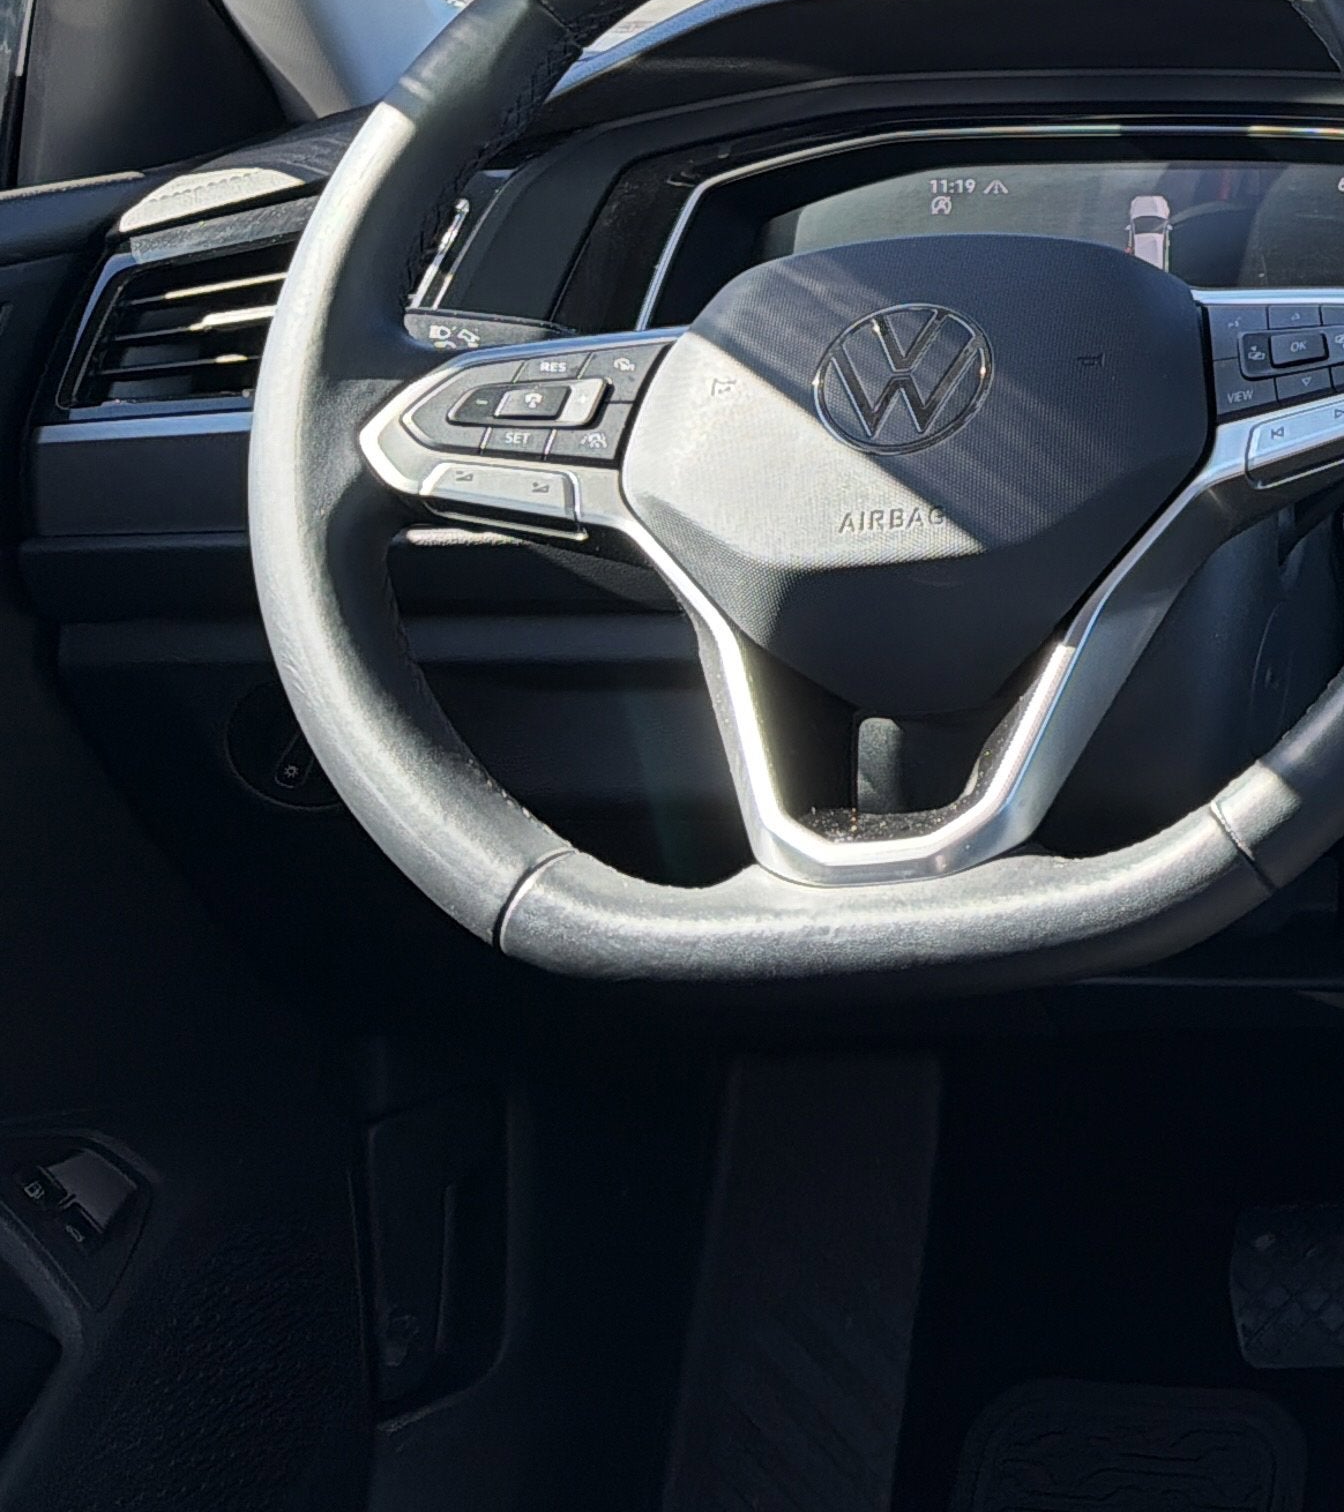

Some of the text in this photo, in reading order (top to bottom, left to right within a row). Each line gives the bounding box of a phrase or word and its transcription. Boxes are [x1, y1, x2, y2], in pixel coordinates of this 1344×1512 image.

[929, 178, 976, 194] 11:19
[1290, 341, 1308, 353] OK
[540, 361, 567, 373] RES
[1226, 389, 1255, 405] VIEW
[504, 432, 531, 445] SET
[838, 505, 946, 534] AIRBAG
